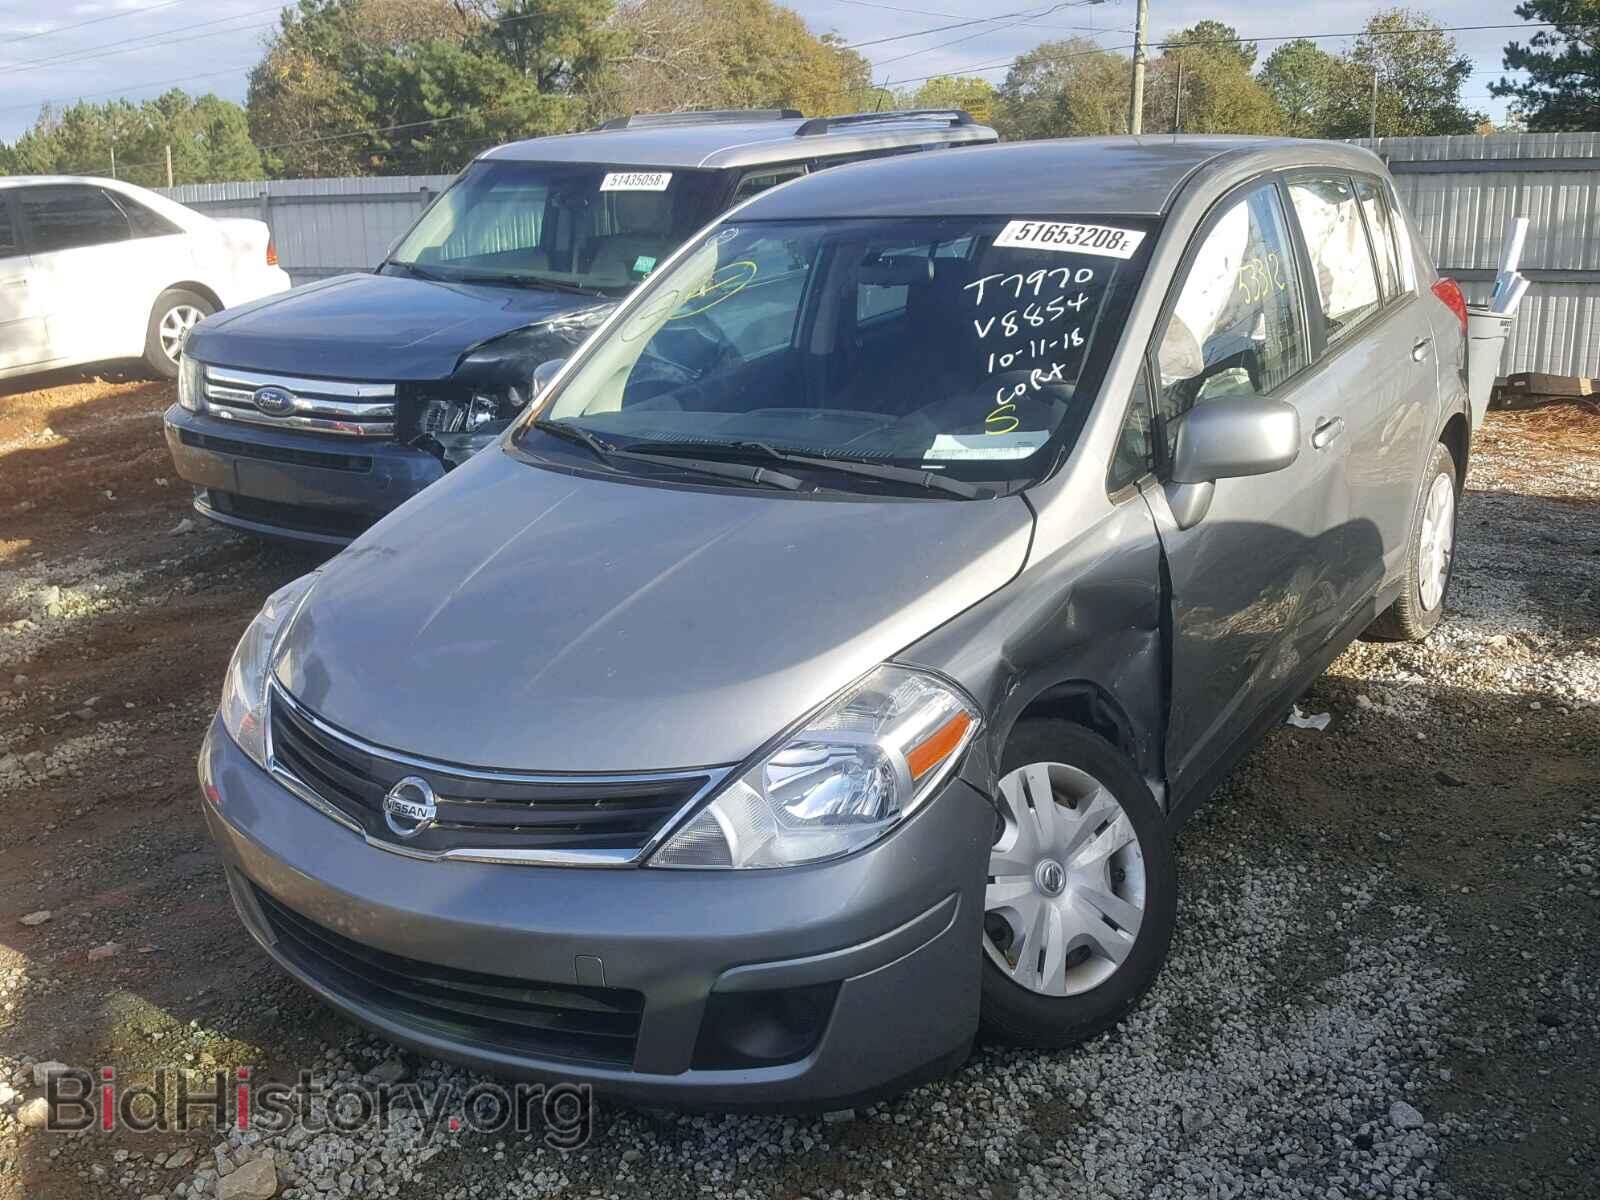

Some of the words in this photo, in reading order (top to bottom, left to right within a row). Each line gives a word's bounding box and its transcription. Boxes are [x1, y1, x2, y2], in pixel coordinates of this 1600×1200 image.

[1015, 222, 1125, 250] 51653208
[988, 327, 1084, 373] 10-11-18
[384, 799, 428, 818] NISSAN
